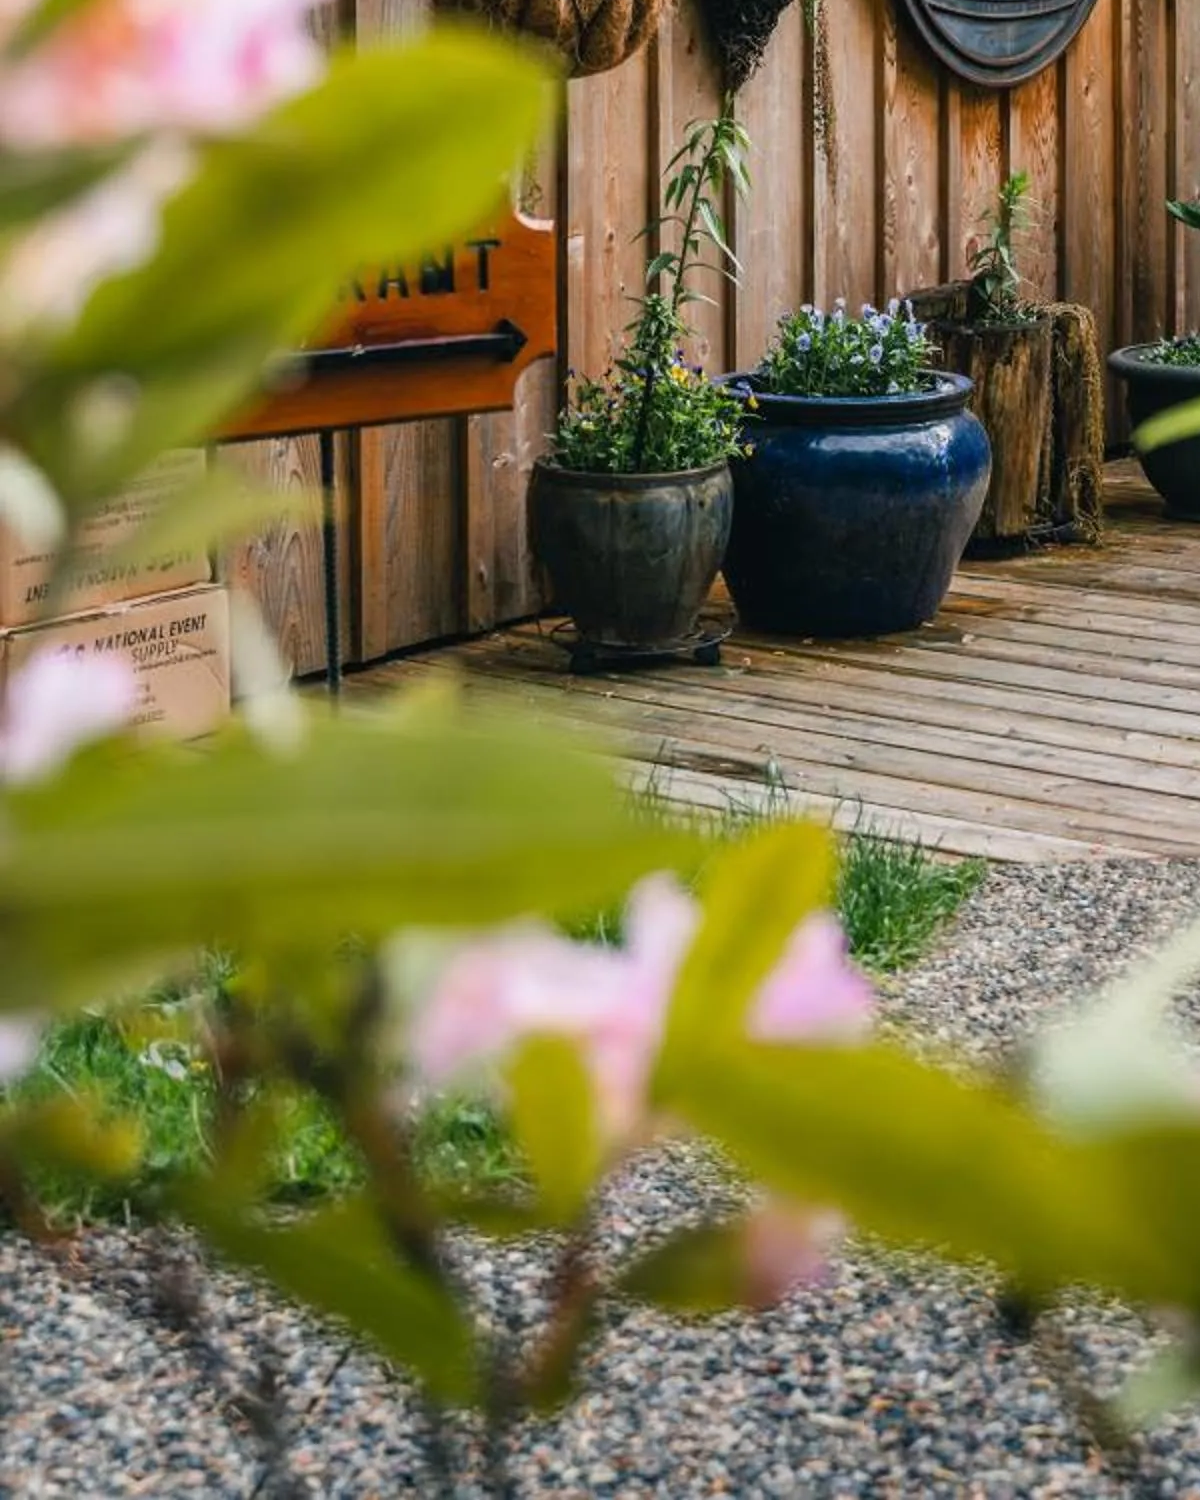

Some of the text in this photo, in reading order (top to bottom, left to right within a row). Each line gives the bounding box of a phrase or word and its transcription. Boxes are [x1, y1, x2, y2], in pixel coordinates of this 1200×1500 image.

[94, 612, 207, 653] NATIONAL EVENT
[131, 638, 180, 663] SUPPLY
